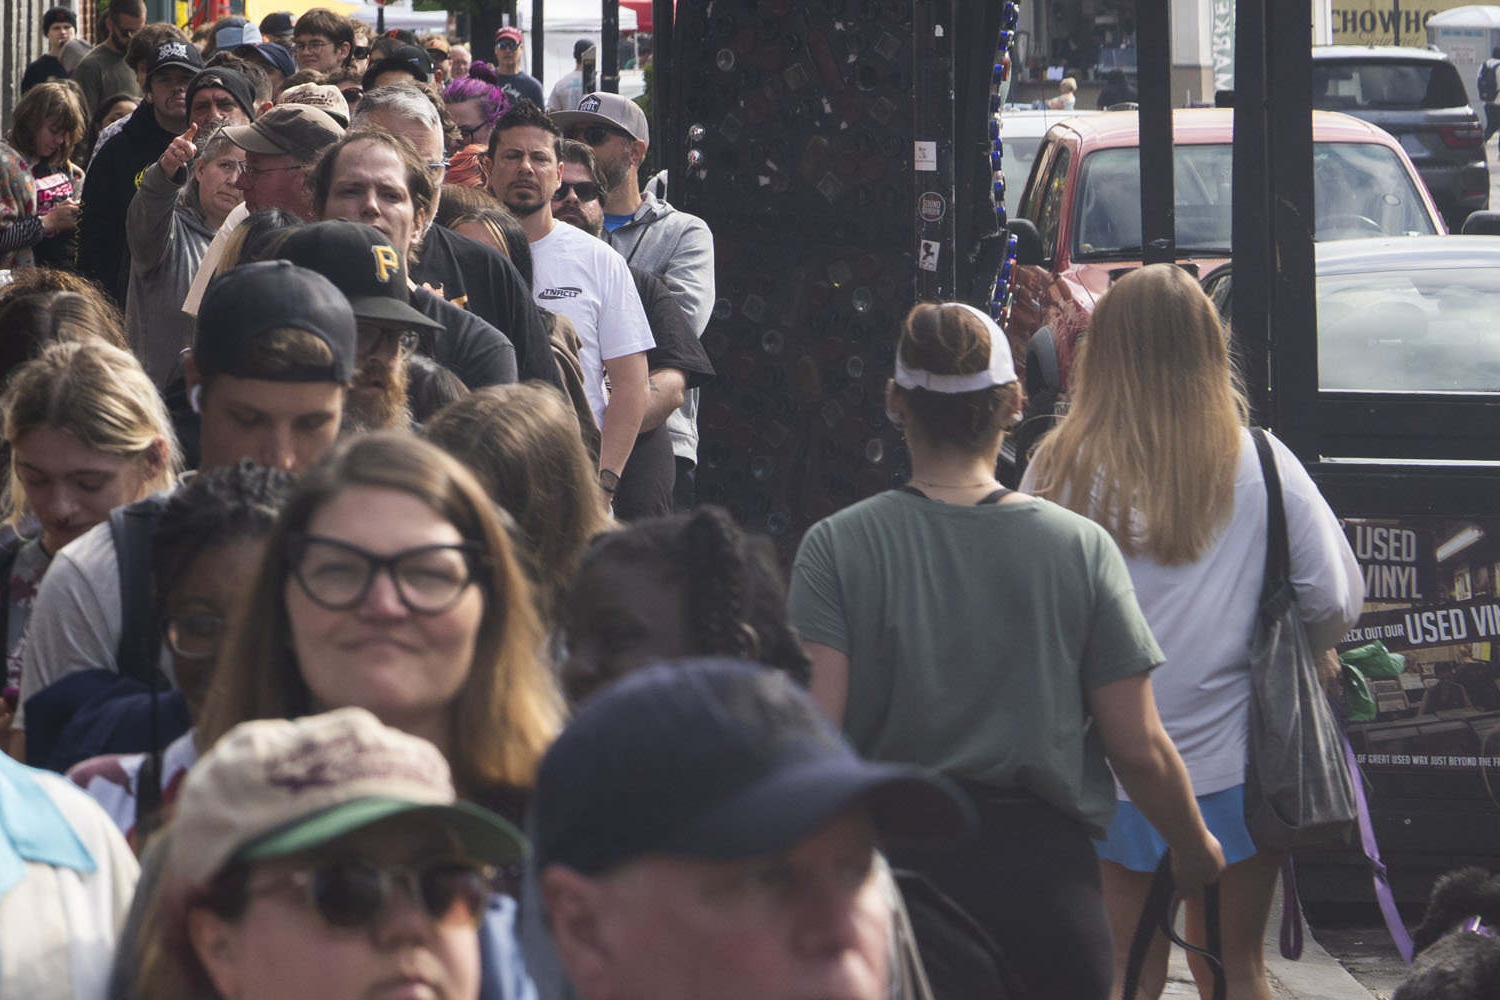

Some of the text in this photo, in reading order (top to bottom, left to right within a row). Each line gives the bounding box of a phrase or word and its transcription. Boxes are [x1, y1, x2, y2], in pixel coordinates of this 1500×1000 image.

[923, 200, 941, 209] SOUND
[371, 245, 399, 283] P
[1356, 526, 1417, 562] USED
[1362, 564, 1422, 599] VINYL
[1340, 624, 1364, 643] ECK
[1365, 625, 1383, 640] OUT
[1385, 623, 1405, 638] OUR
[1405, 608, 1467, 645] USED
[1357, 754, 1367, 764] OF
[1368, 754, 1390, 764] GREAT
[1392, 754, 1411, 765] USED
[1411, 755, 1429, 765] WAX
[1430, 755, 1448, 766] JUST
[1448, 756, 1477, 766] BEYOND
[1478, 756, 1492, 767] THE
